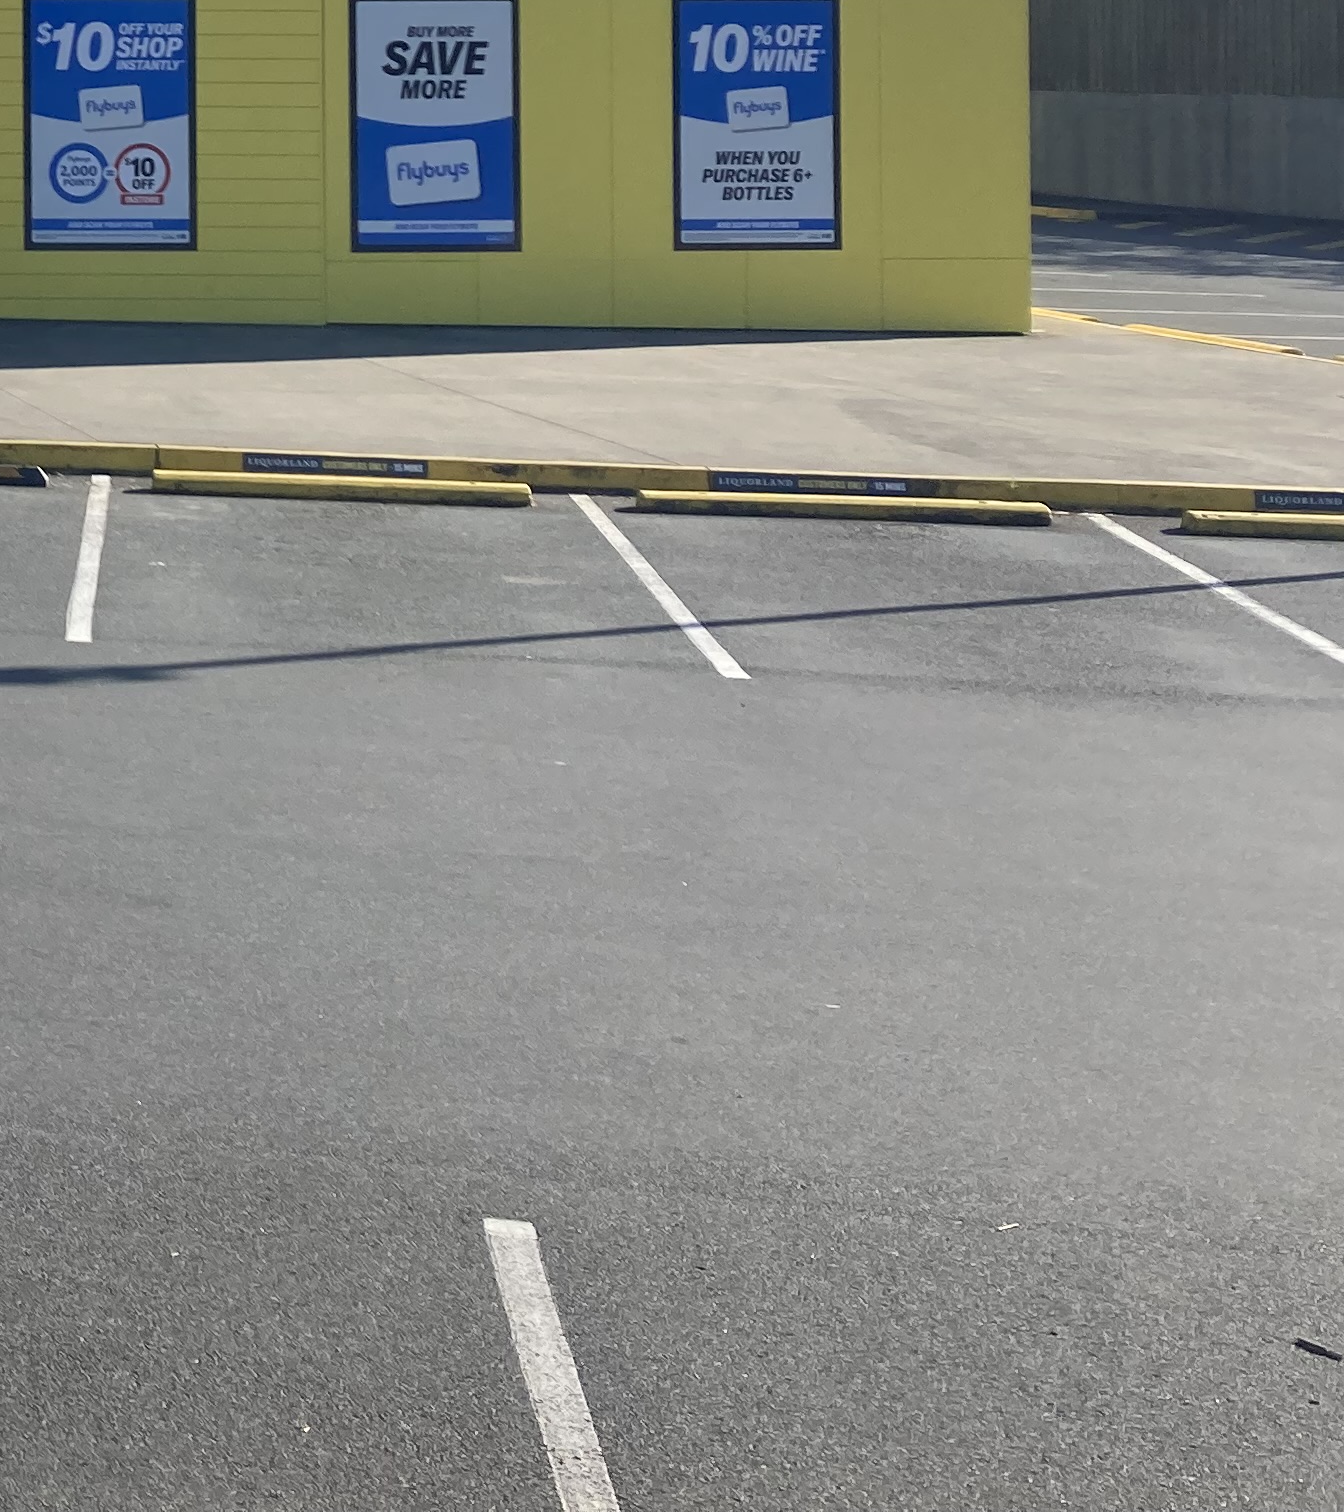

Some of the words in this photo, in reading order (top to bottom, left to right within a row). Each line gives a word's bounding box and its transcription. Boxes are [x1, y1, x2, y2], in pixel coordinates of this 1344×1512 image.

[118, 22, 144, 35] OFF
[146, 22, 184, 35] YOUR
[407, 26, 434, 38] BUY
[436, 26, 475, 37] MORE
[776, 24, 823, 47] OFF
[36, 21, 115, 72] $10
[115, 36, 184, 58] SHOP
[381, 40, 489, 76] SAVE
[400, 79, 467, 100] MORE
[716, 151, 764, 165] WHEN
[767, 151, 801, 165] YOU
[60, 165, 98, 178] 2,000
[124, 157, 155, 178] $10
[63, 178, 97, 187] POINTS
[702, 169, 790, 183] PURCHASE
[793, 169, 813, 183] 6+
[132, 178, 156, 190] OFF
[722, 187, 794, 201] BOTTLES
[247, 457, 318, 469] LIQUORLAND
[718, 476, 794, 487] LIQUORLAND
[1262, 494, 1343, 506] LIQUORLAND
